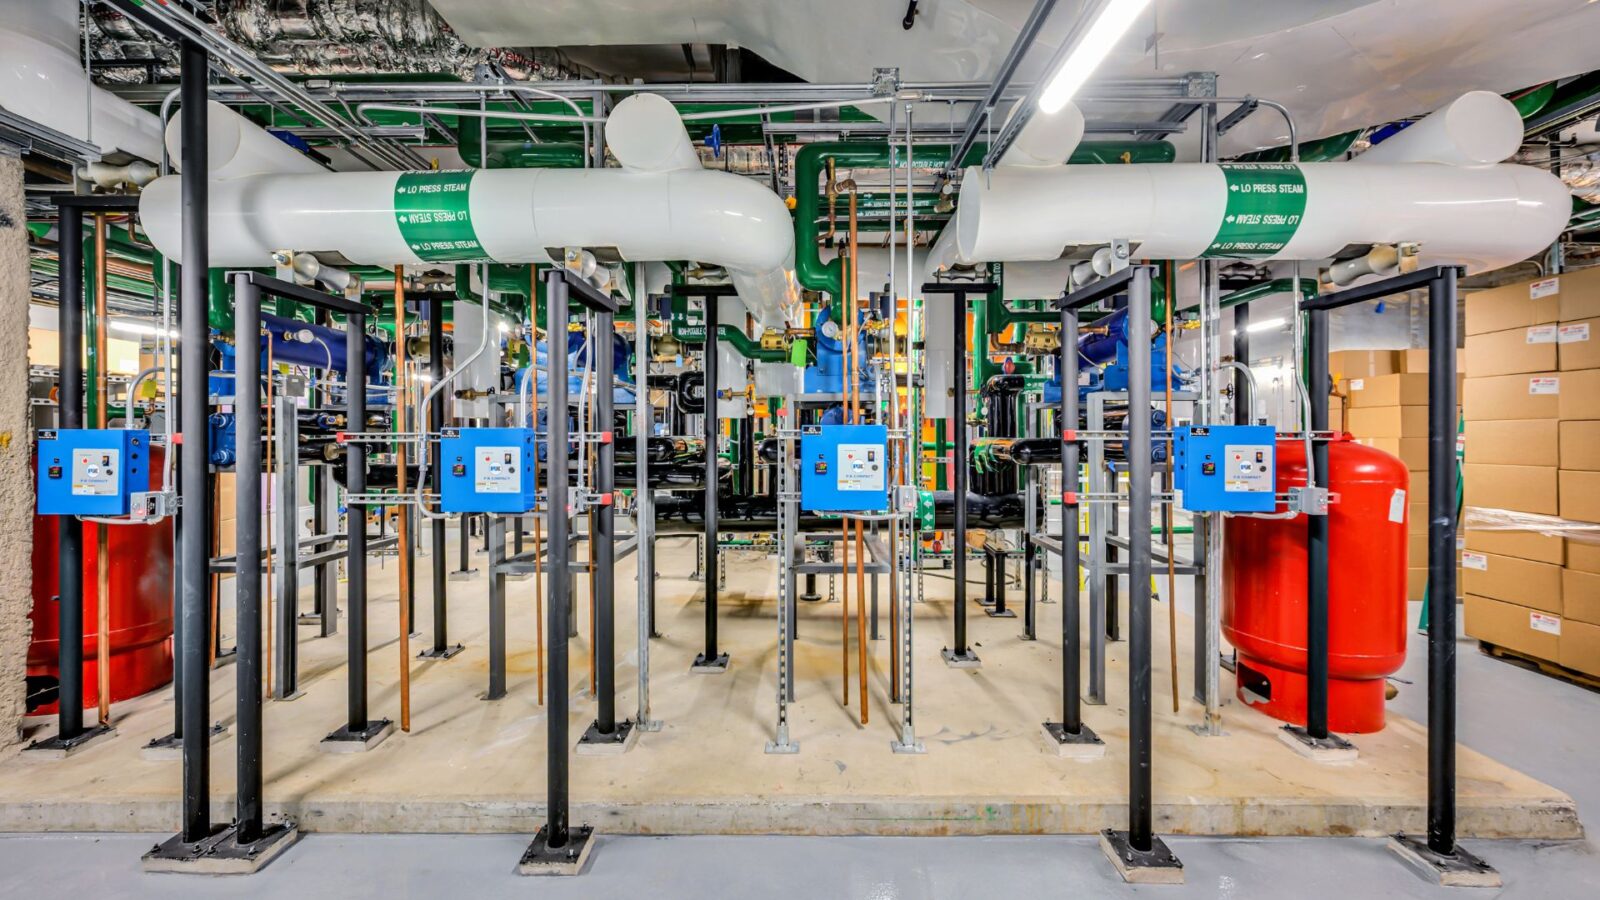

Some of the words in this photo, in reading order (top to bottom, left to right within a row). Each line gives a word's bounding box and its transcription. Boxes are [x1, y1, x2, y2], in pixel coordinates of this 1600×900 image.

[407, 186, 417, 194] LO
[418, 185, 441, 193] PRESS
[443, 183, 467, 192] STEAM
[1240, 184, 1251, 193] LO
[1253, 184, 1277, 193] PRESS
[1279, 184, 1304, 193] STEAM
[408, 213, 432, 224] STEAM
[433, 212, 456, 222] PRESS
[457, 211, 468, 221] LO
[1235, 214, 1261, 225] STEAM
[1262, 215, 1287, 225] PRESS
[1287, 215, 1299, 225] LO
[420, 243, 431, 251] LO
[431, 242, 454, 250] PRESS
[454, 240, 479, 249] STEAM
[1256, 242, 1284, 250] STEAM
